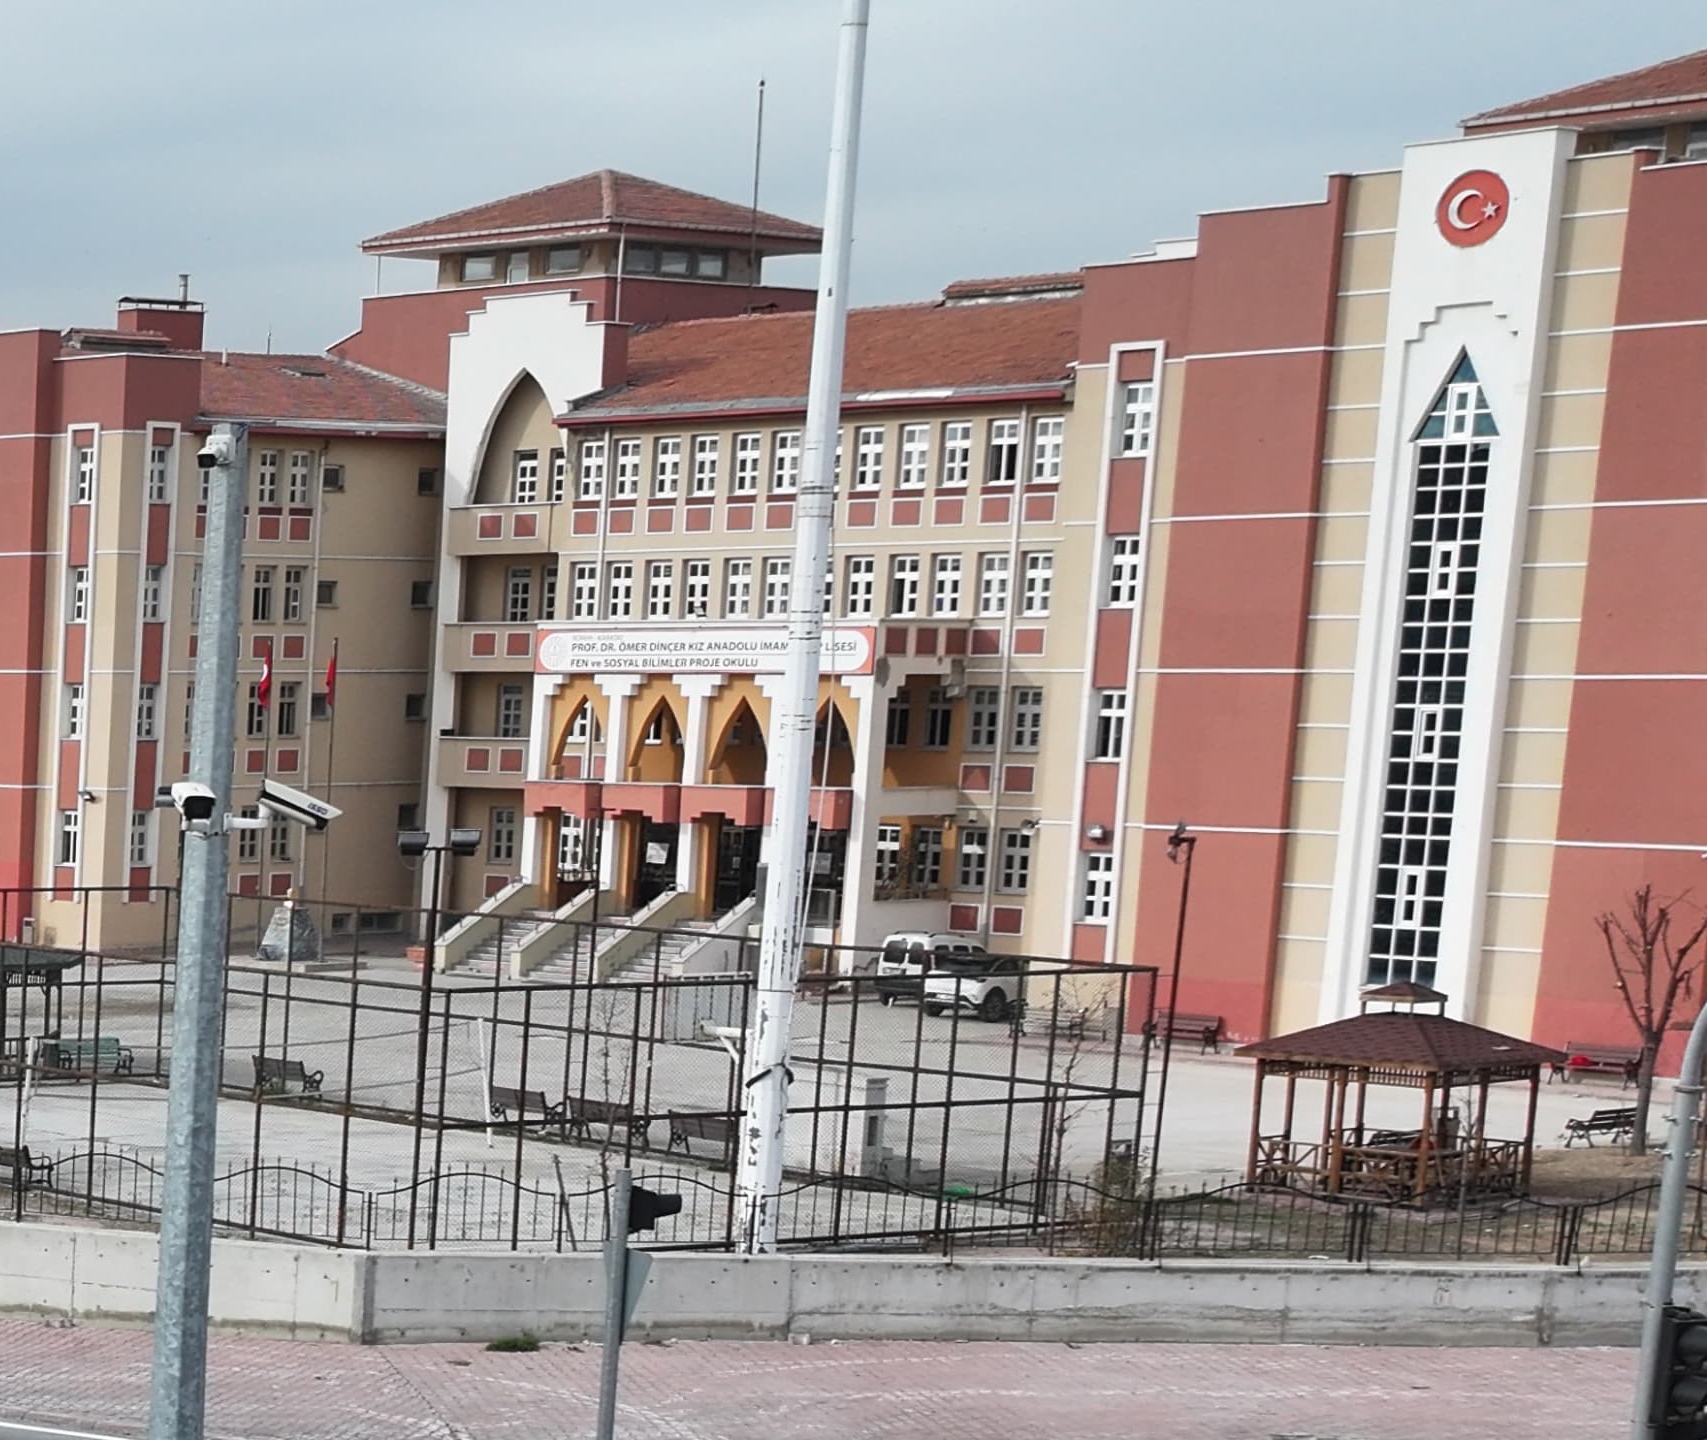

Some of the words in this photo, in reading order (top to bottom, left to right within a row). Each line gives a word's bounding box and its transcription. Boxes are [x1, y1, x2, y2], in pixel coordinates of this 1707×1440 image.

[571, 643, 599, 652] PROF.
[619, 641, 647, 652] ÖMER
[649, 641, 686, 653] DİNÇER
[689, 642, 705, 651] KIZ
[707, 641, 758, 651] ANADOLU
[570, 659, 589, 667] FEN
[603, 658, 639, 667] SOSYAL
[641, 657, 687, 668] BİLİMLER
[689, 658, 721, 667] PROJE
[723, 658, 758, 667] OKULU
